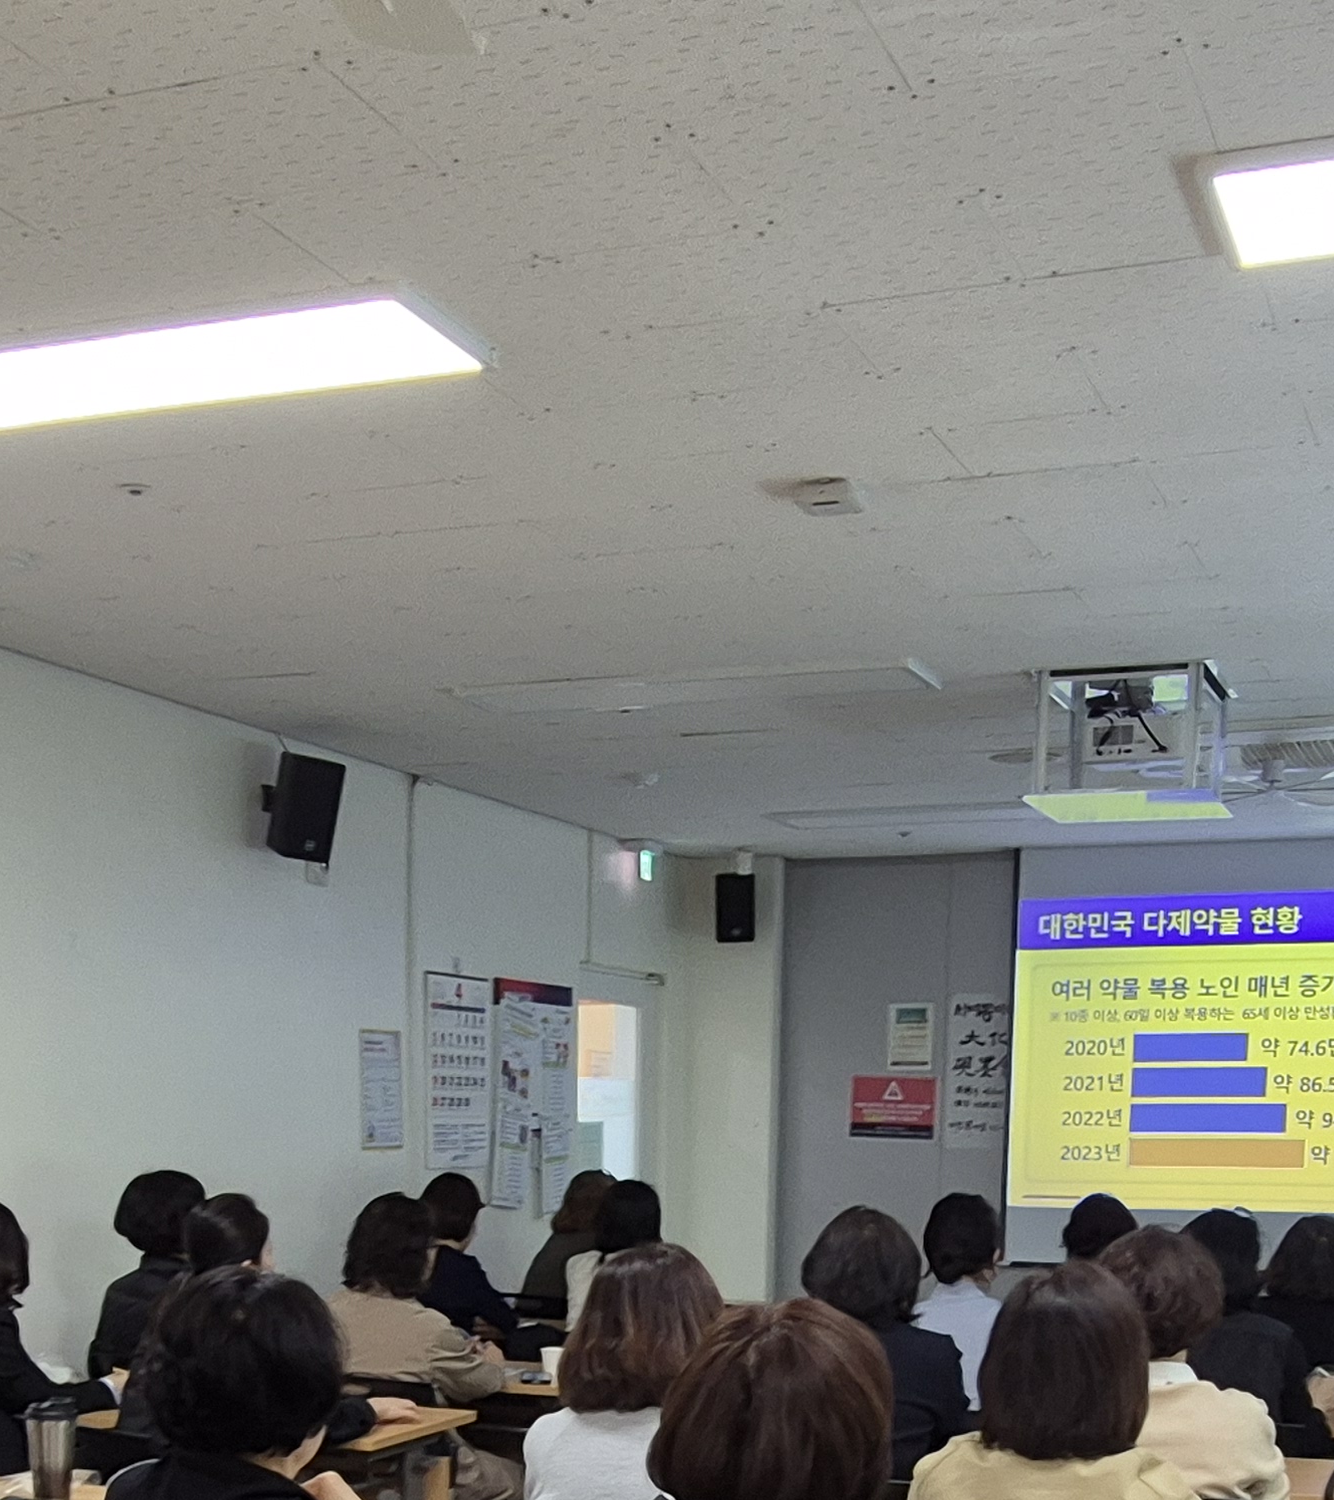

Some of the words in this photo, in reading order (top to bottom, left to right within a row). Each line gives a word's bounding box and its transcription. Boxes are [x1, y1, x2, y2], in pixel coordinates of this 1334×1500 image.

[1038, 910, 1135, 940] 대한민국
[1142, 907, 1243, 938] 다제약물
[1250, 905, 1303, 935] 현황
[1051, 978, 1092, 1001] 여러
[1098, 977, 1141, 1001] 약물
[1147, 976, 1191, 1000] 복용
[1197, 975, 1240, 999] 노인
[1247, 974, 1291, 999] 매년
[1154, 1007, 1179, 1022] 이상
[1183, 1006, 1235, 1022] 복용하는
[1241, 1005, 1270, 1021] 65세
[1274, 1005, 1300, 1021] 이상
[1064, 1037, 1126, 1058] 2020년
[1261, 1037, 1280, 1058] 약
[1062, 1073, 1124, 1093] 2021년
[1273, 1074, 1293, 1094] 약
[1061, 1108, 1123, 1129] 2022년
[1295, 1109, 1316, 1130] 약
[1060, 1144, 1121, 1163] 2023년
[1310, 1145, 1331, 1166] 약
